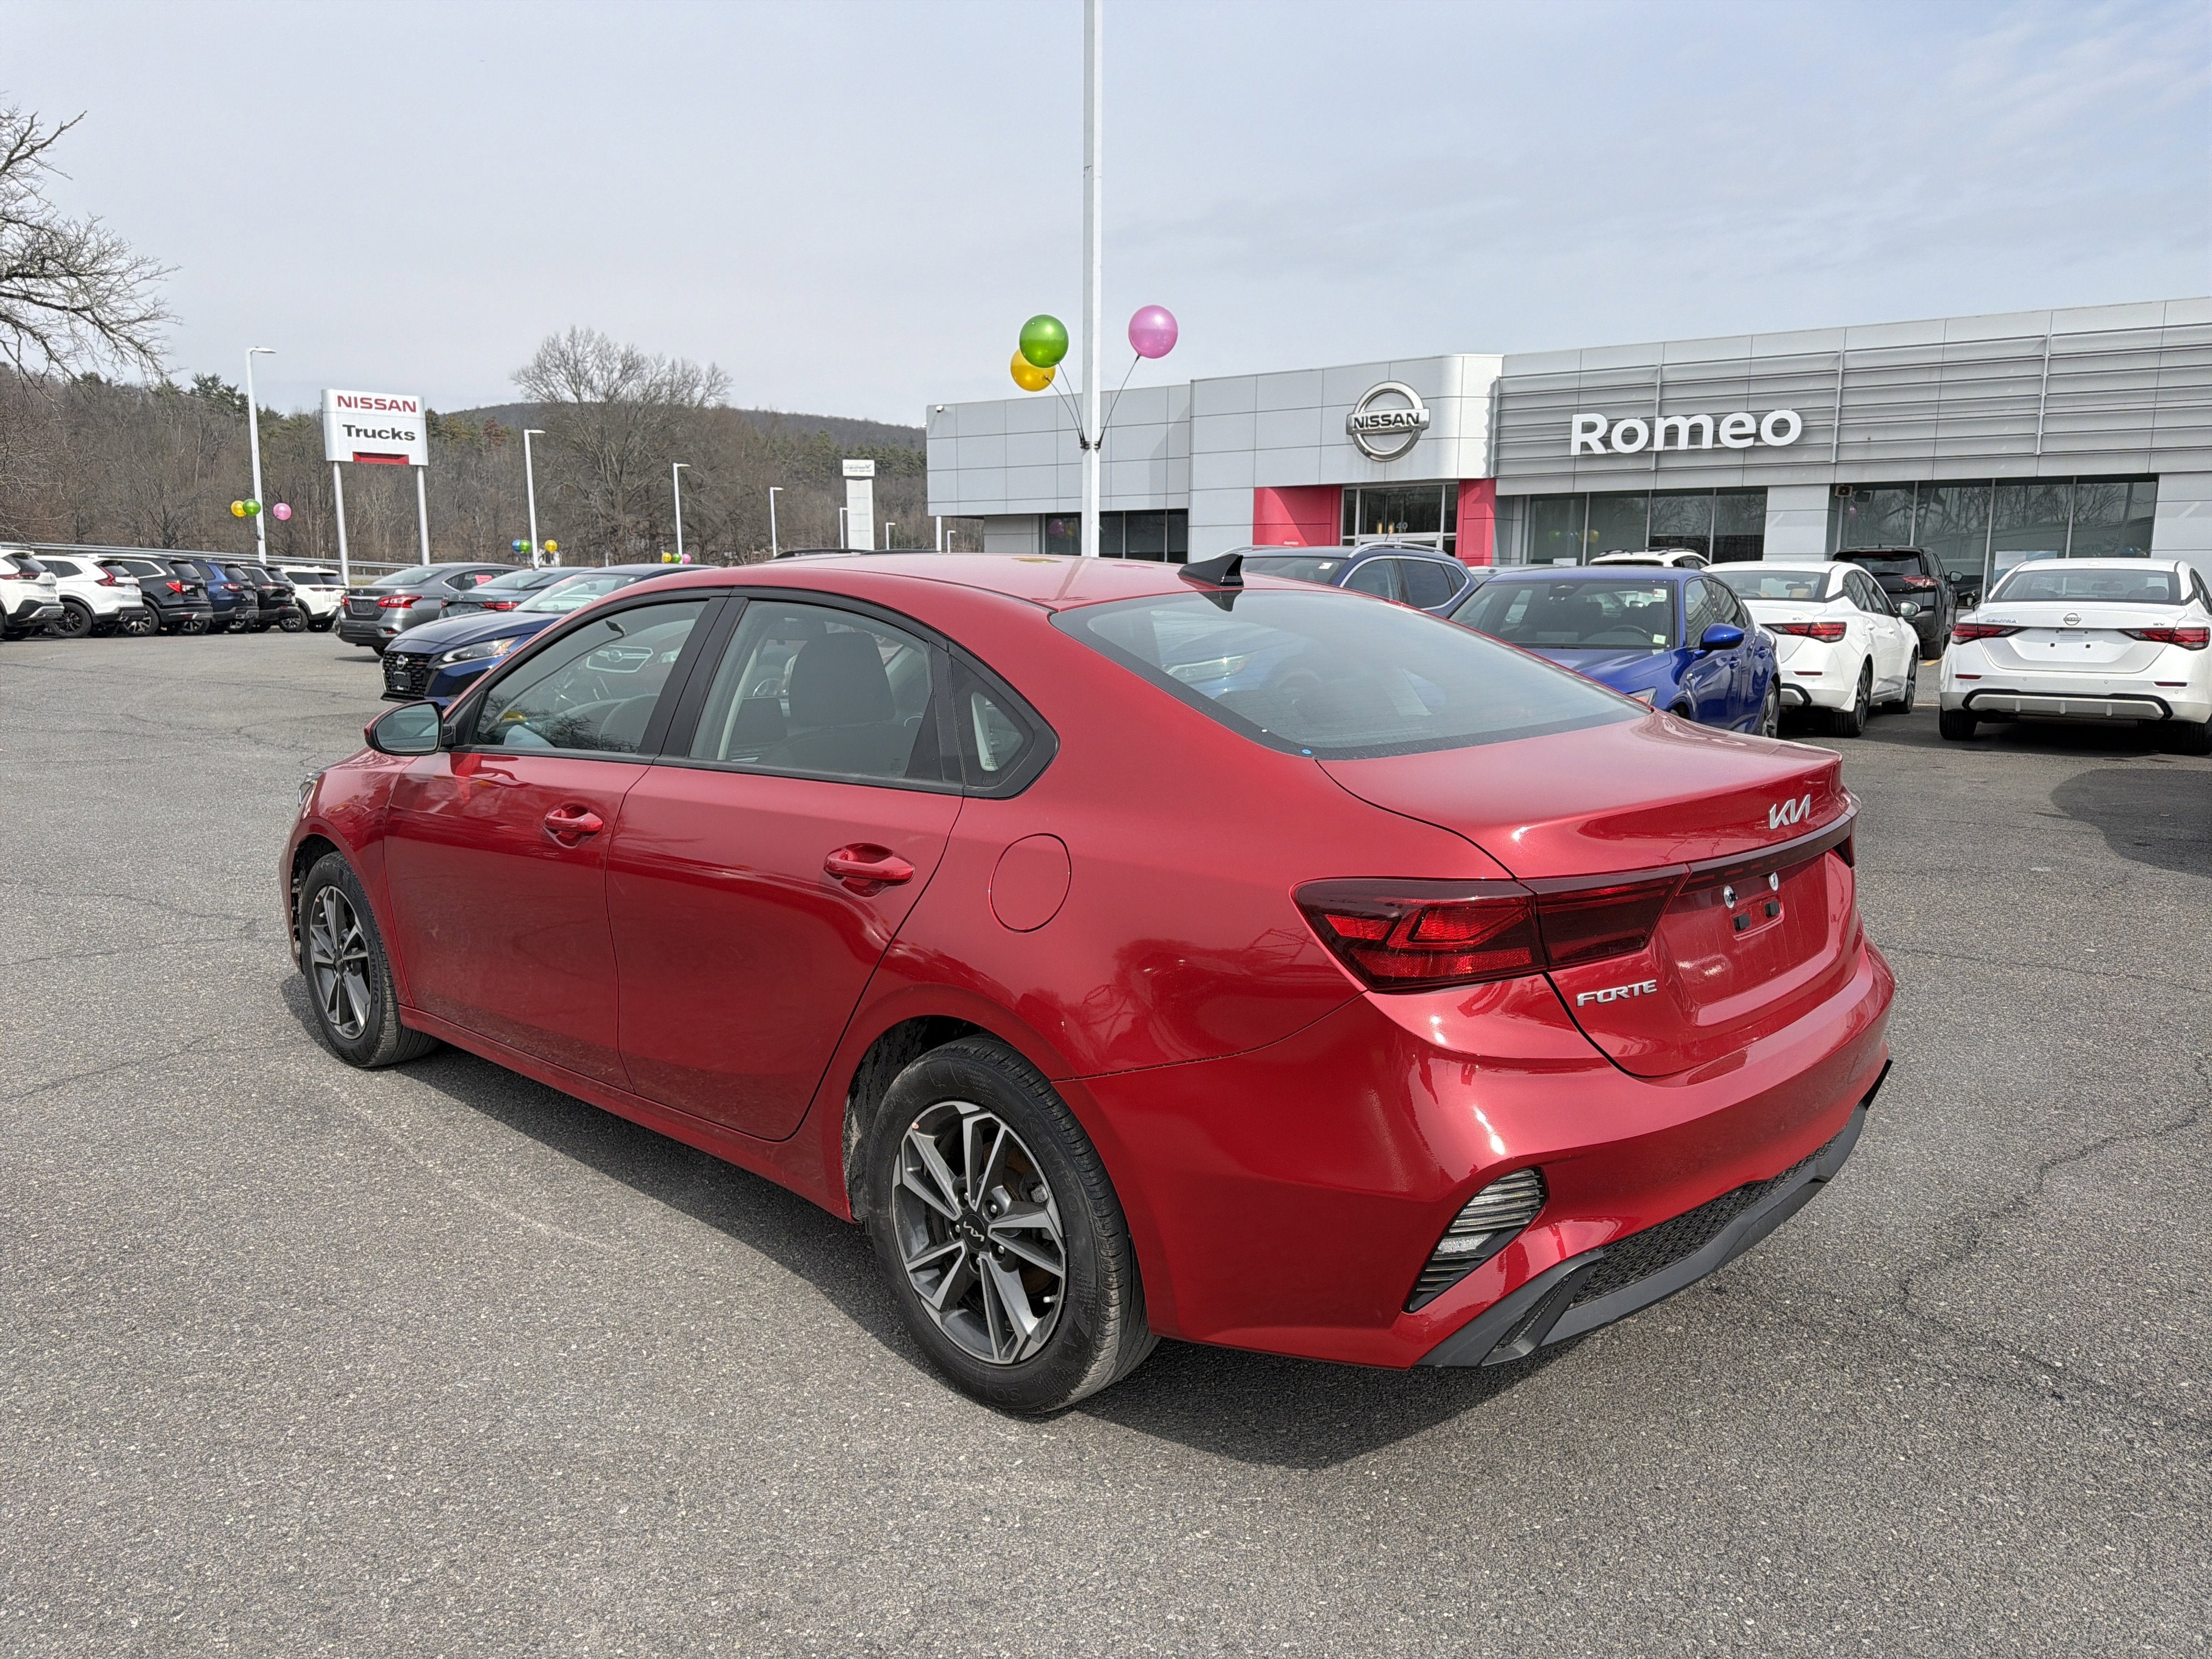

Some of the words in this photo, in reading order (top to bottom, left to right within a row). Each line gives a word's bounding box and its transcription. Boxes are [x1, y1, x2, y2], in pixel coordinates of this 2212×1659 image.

[337, 395, 416, 413] NISSAN
[1353, 412, 1420, 430] NISSAN
[342, 424, 416, 441] Trucks
[1570, 409, 1803, 456] Romeo
[1576, 979, 1657, 1008] FORTE
